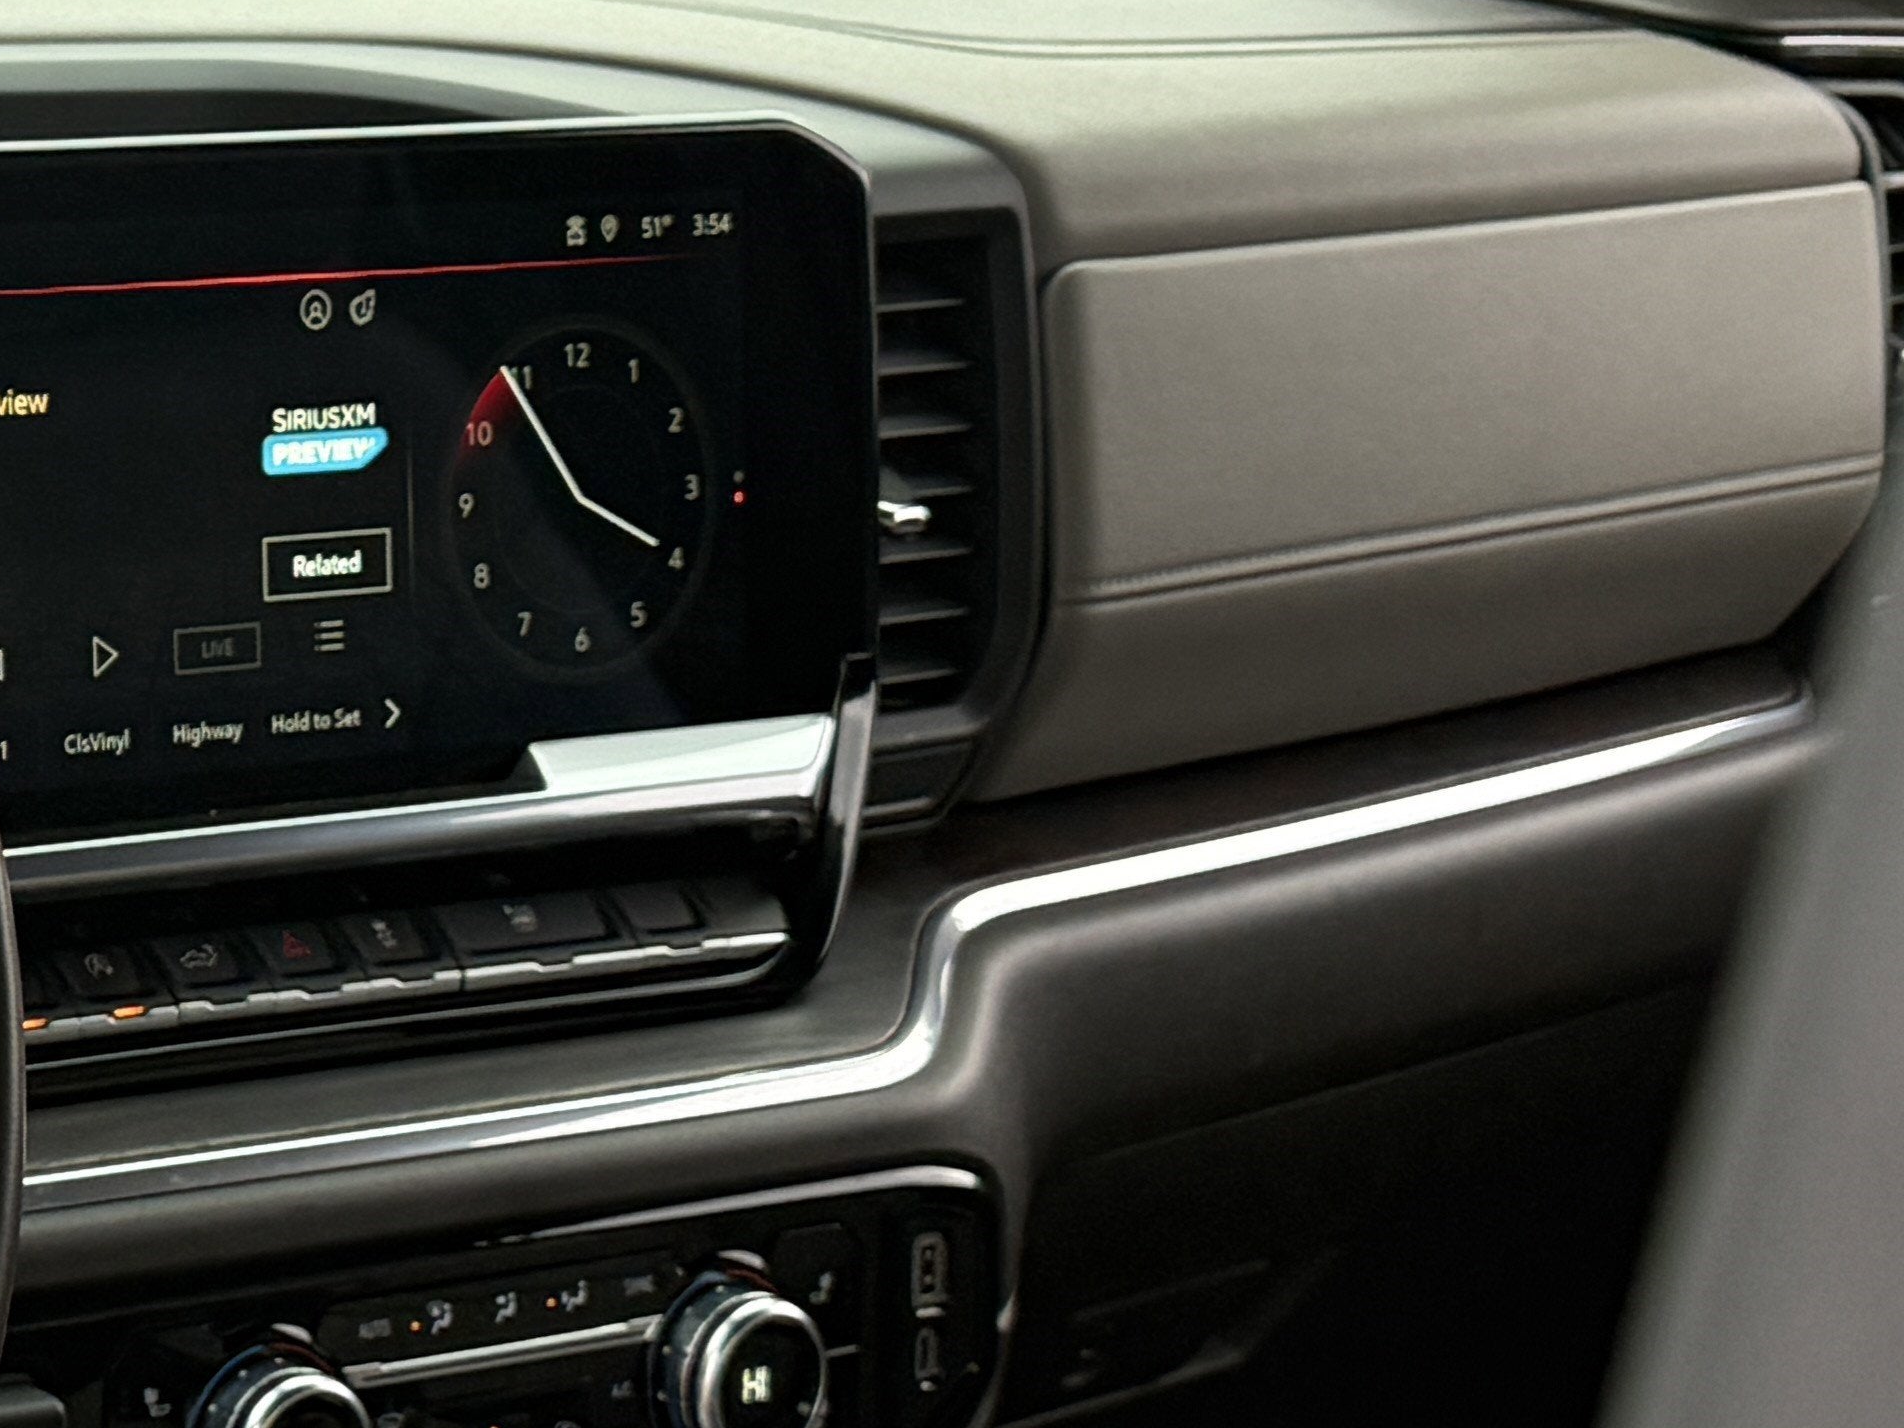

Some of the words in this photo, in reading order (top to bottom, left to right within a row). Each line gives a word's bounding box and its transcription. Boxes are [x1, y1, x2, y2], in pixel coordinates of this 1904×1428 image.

[564, 342, 592, 368] 12
[628, 358, 640, 383] 1
[272, 402, 376, 432] SIRIUSXM
[667, 407, 684, 433] 2
[465, 421, 493, 446] 10
[272, 437, 376, 466] PREVIEW
[684, 474, 699, 500] 3
[458, 492, 474, 519] 9
[293, 549, 362, 578] Related
[668, 546, 685, 570] 4
[473, 562, 490, 589] 8
[517, 611, 532, 637] 7
[630, 601, 647, 628] 5
[201, 637, 234, 659] LIVE
[575, 627, 590, 653] 6
[173, 720, 243, 748] Highway
[271, 710, 309, 734] Hold
[313, 713, 331, 731] to
[333, 708, 362, 729] Set
[64, 728, 131, 756] ClsVinyl
